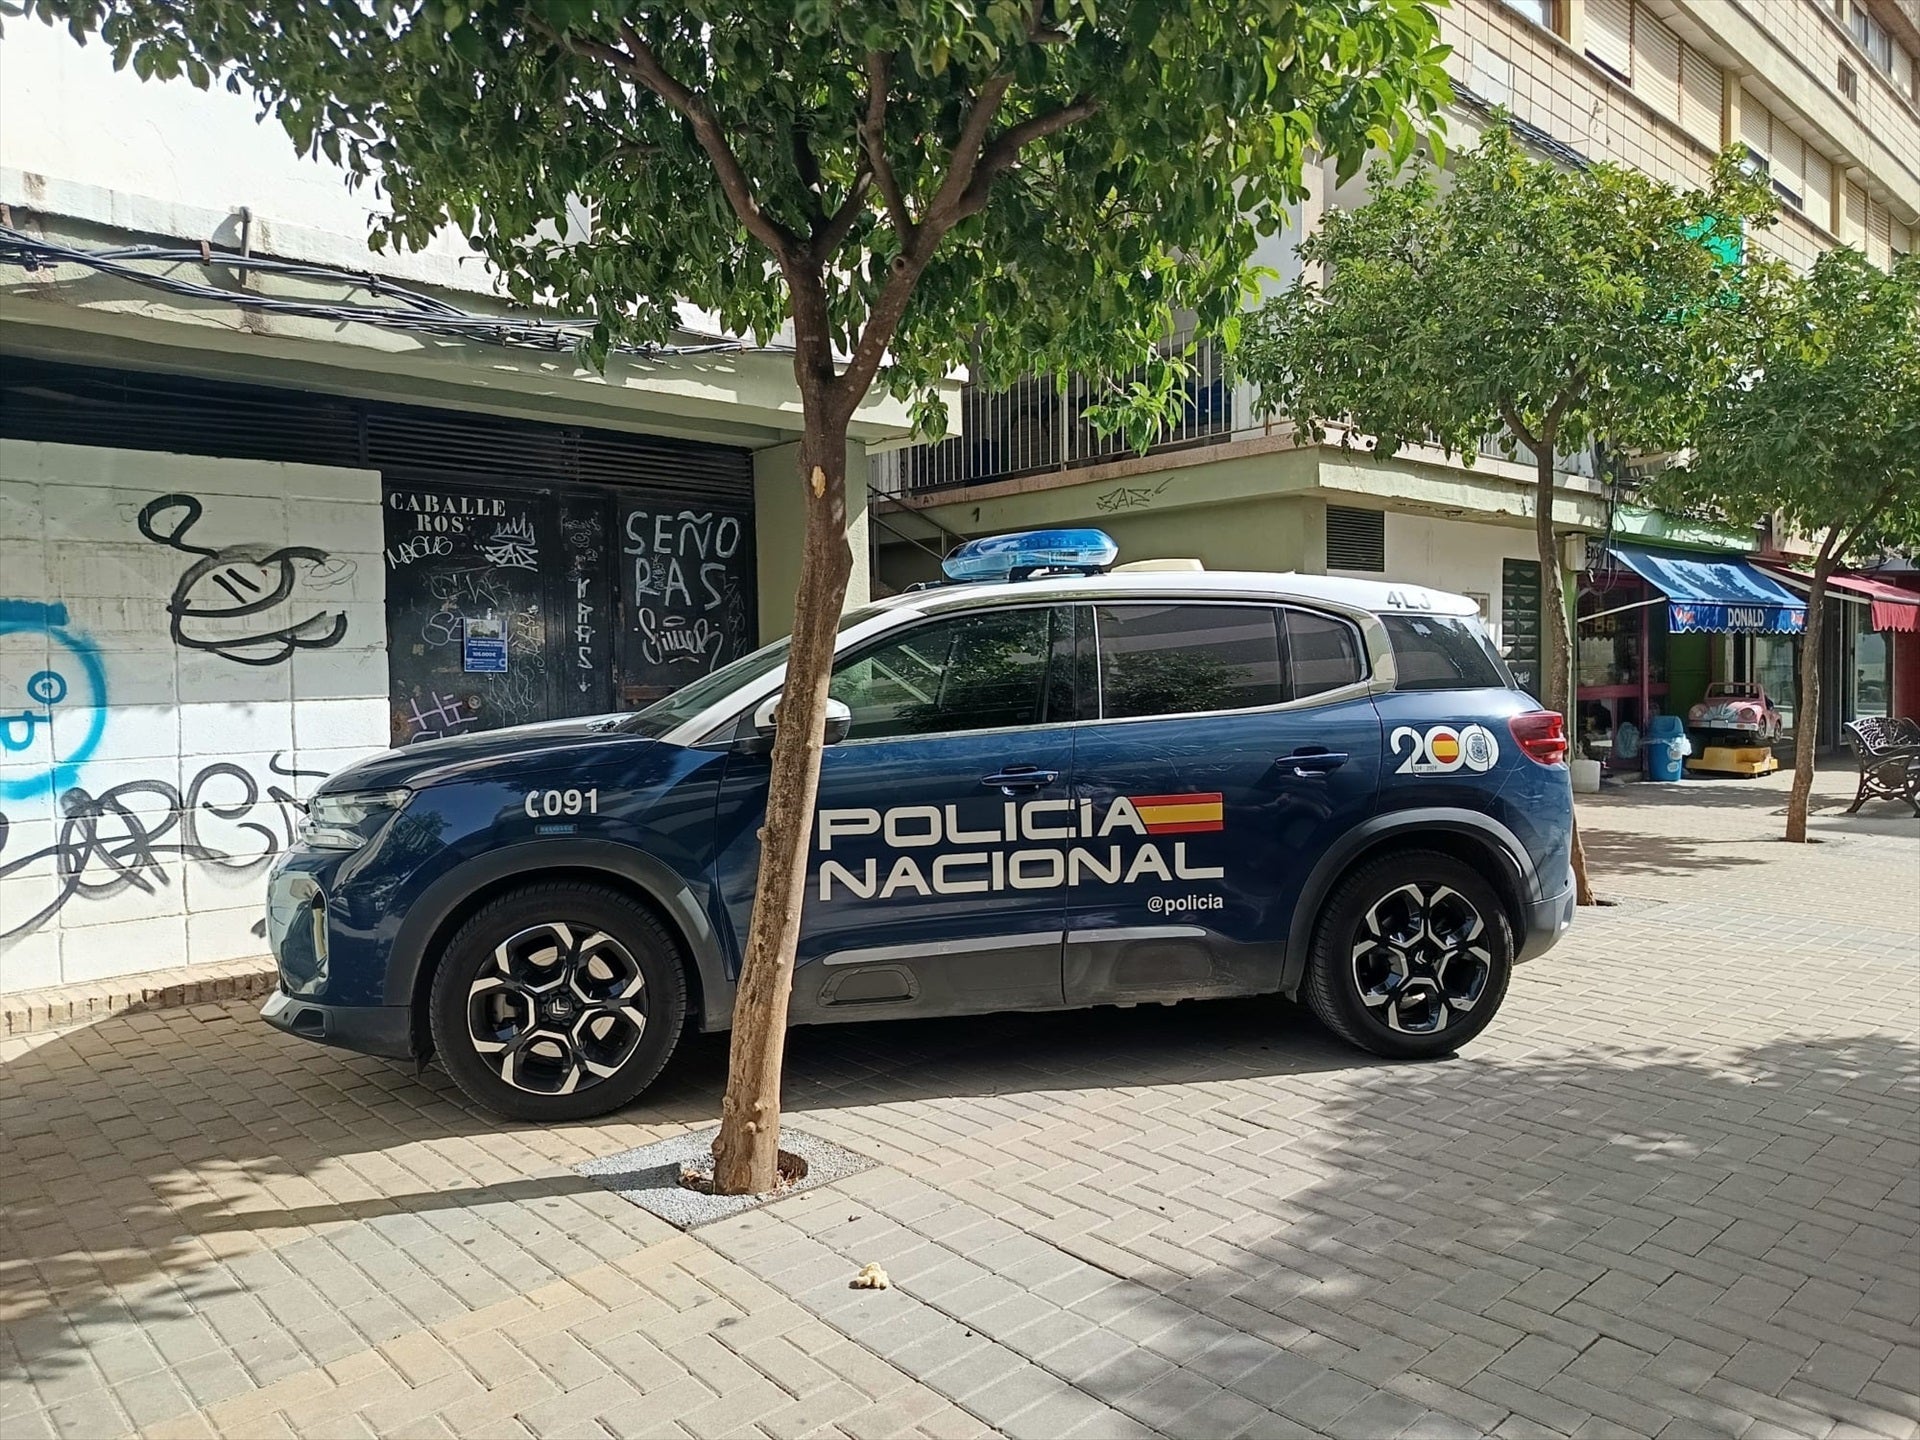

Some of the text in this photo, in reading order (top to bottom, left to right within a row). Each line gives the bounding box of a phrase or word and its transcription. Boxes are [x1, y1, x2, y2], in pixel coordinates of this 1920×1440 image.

[389, 492, 506, 517] CABALLE
[417, 514, 464, 533] ROS
[623, 510, 741, 560] SEÑO
[635, 556, 727, 611] RAS
[1727, 607, 1764, 627] DONALD
[1390, 725, 1499, 774] 200
[818, 841, 1225, 901] NACIONAL
[1147, 893, 1224, 916] @policia
